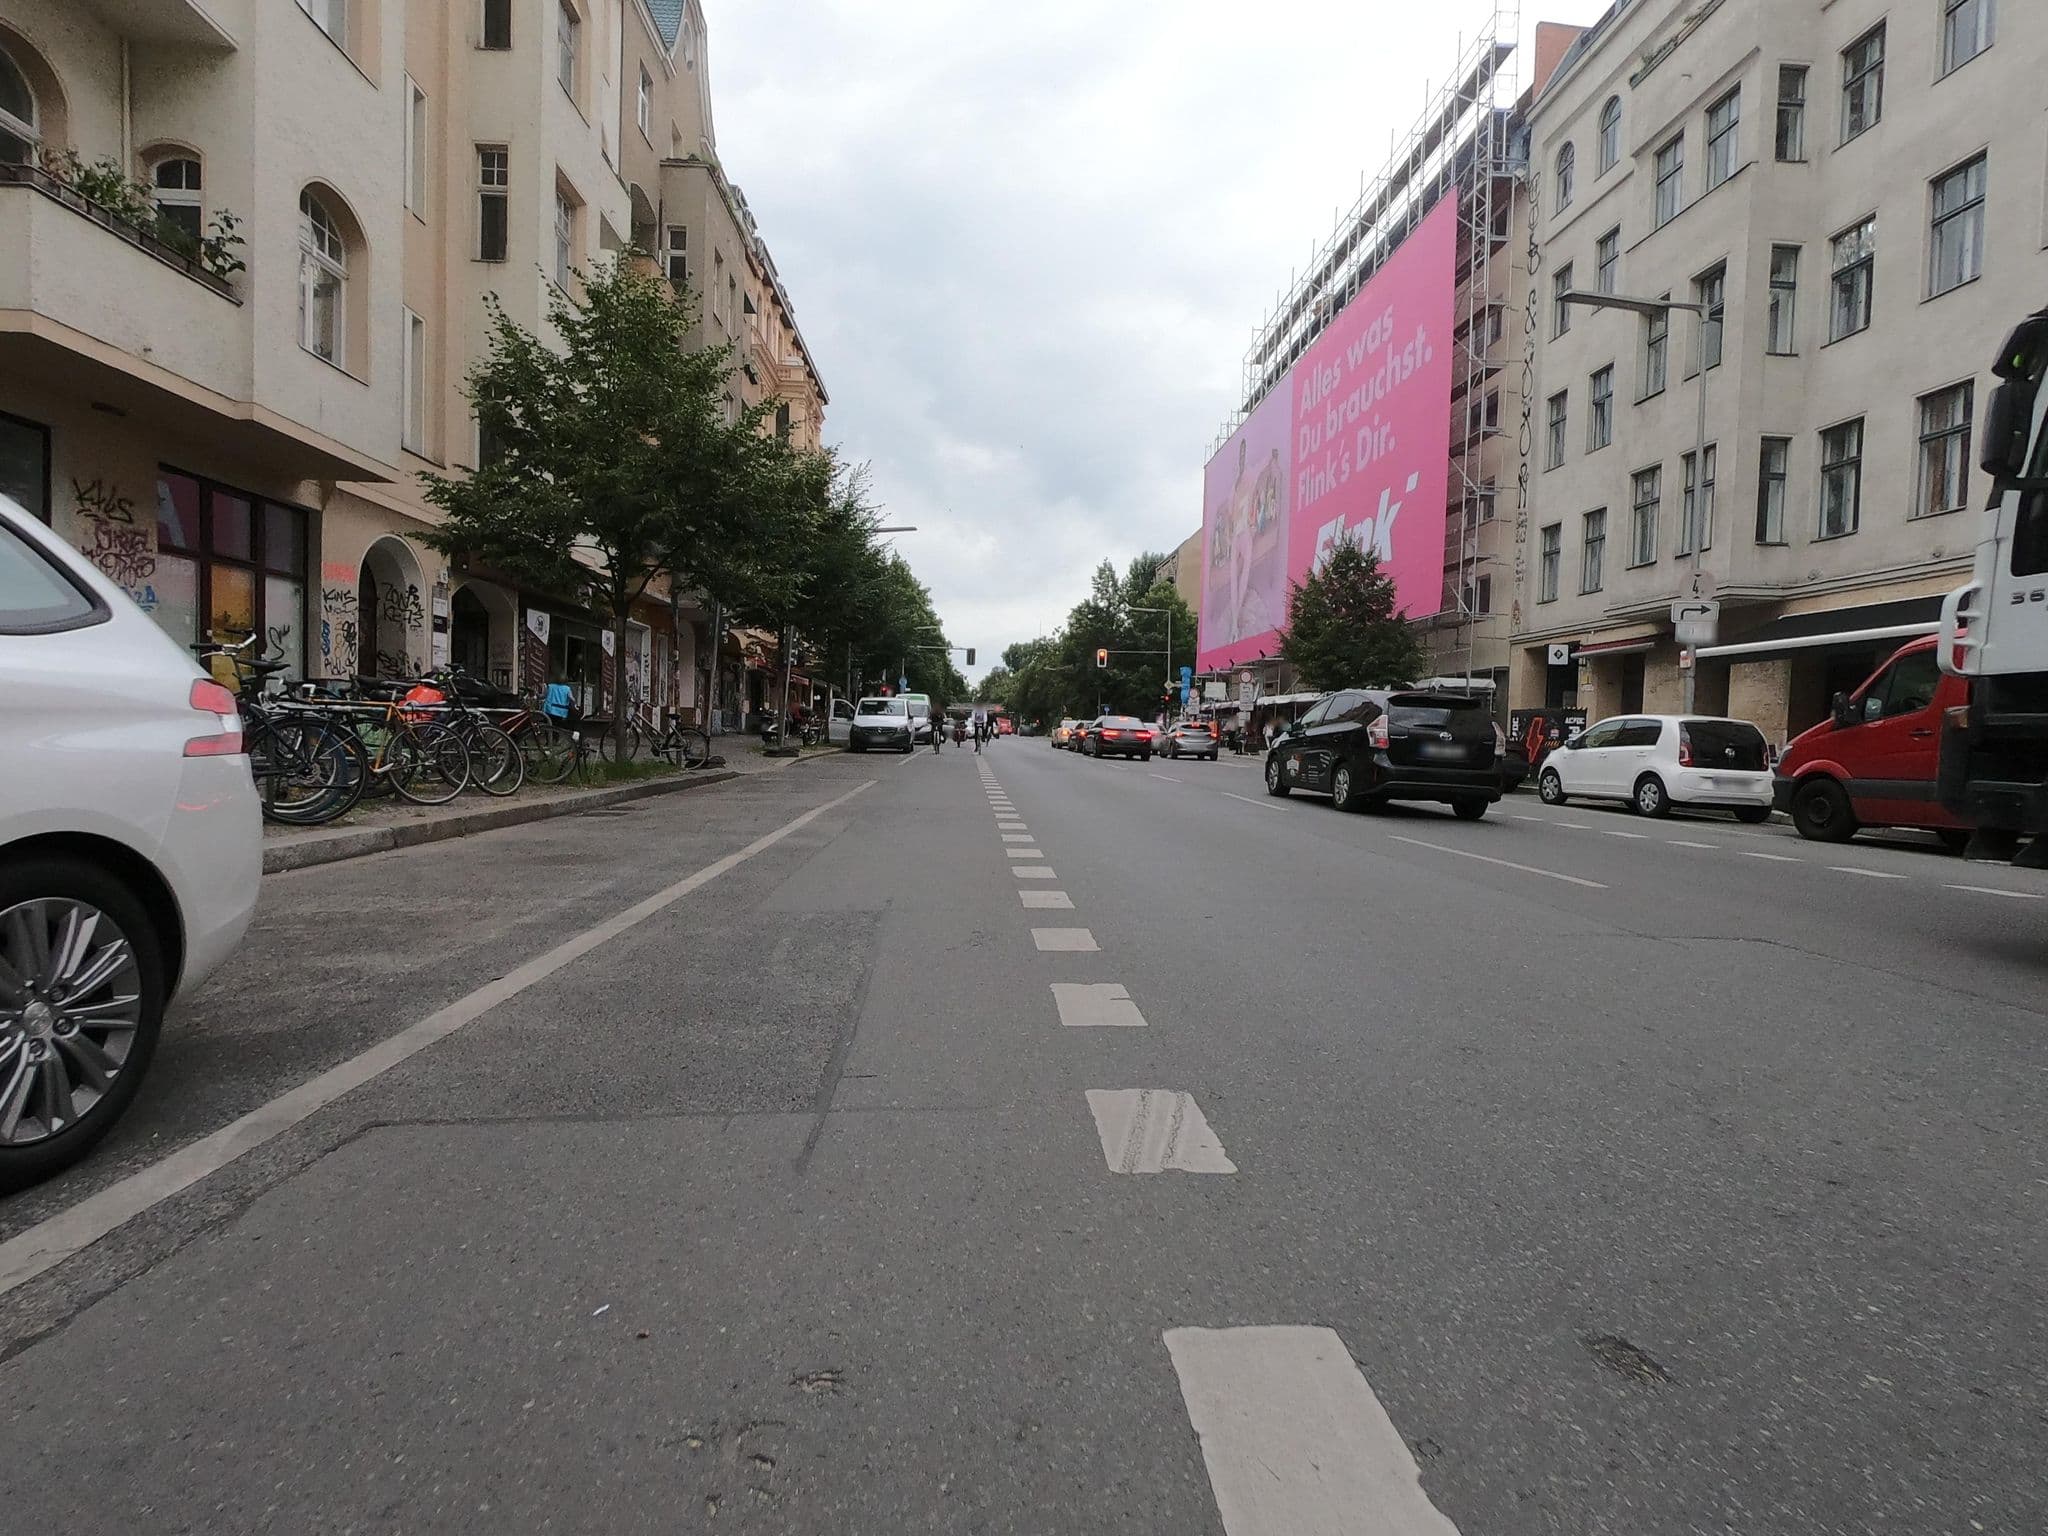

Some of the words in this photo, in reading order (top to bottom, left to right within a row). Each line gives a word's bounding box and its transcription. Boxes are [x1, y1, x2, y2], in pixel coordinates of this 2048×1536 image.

[1299, 423, 1321, 463] Du
[1326, 324, 1433, 441] brauchst.
[1300, 357, 1342, 419] Alles
[1346, 304, 1394, 371] was
[1356, 415, 1396, 472] Dir.
